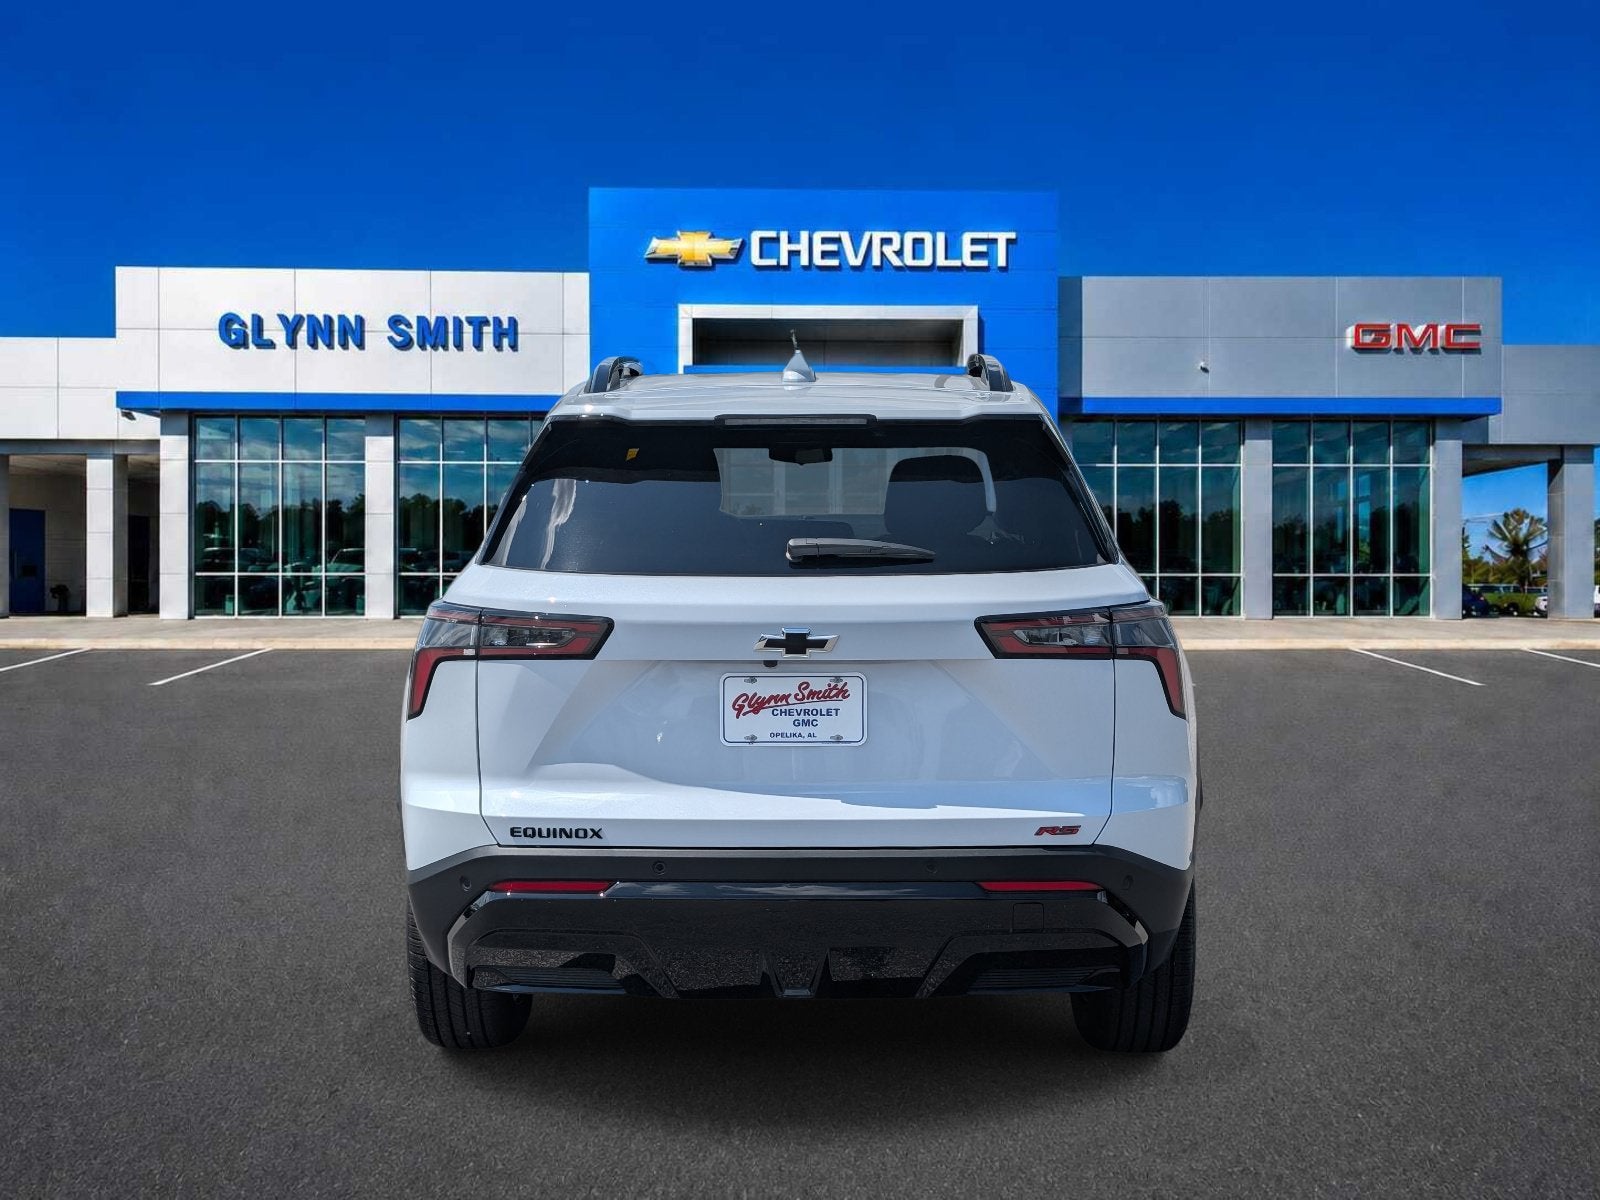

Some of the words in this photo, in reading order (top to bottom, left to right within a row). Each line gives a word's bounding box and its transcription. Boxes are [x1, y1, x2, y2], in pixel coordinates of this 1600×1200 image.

[750, 230, 1017, 268] CHEVROLET
[218, 312, 366, 350] GLYNN
[387, 314, 519, 352] SMITH
[1350, 322, 1482, 352] GMC
[732, 692, 791, 719] Glynn
[794, 681, 850, 701] Smith
[771, 708, 840, 717] CHEVROLET
[792, 719, 819, 727] GMC
[509, 826, 604, 840] EQUINOX
[1034, 825, 1082, 836] RS
